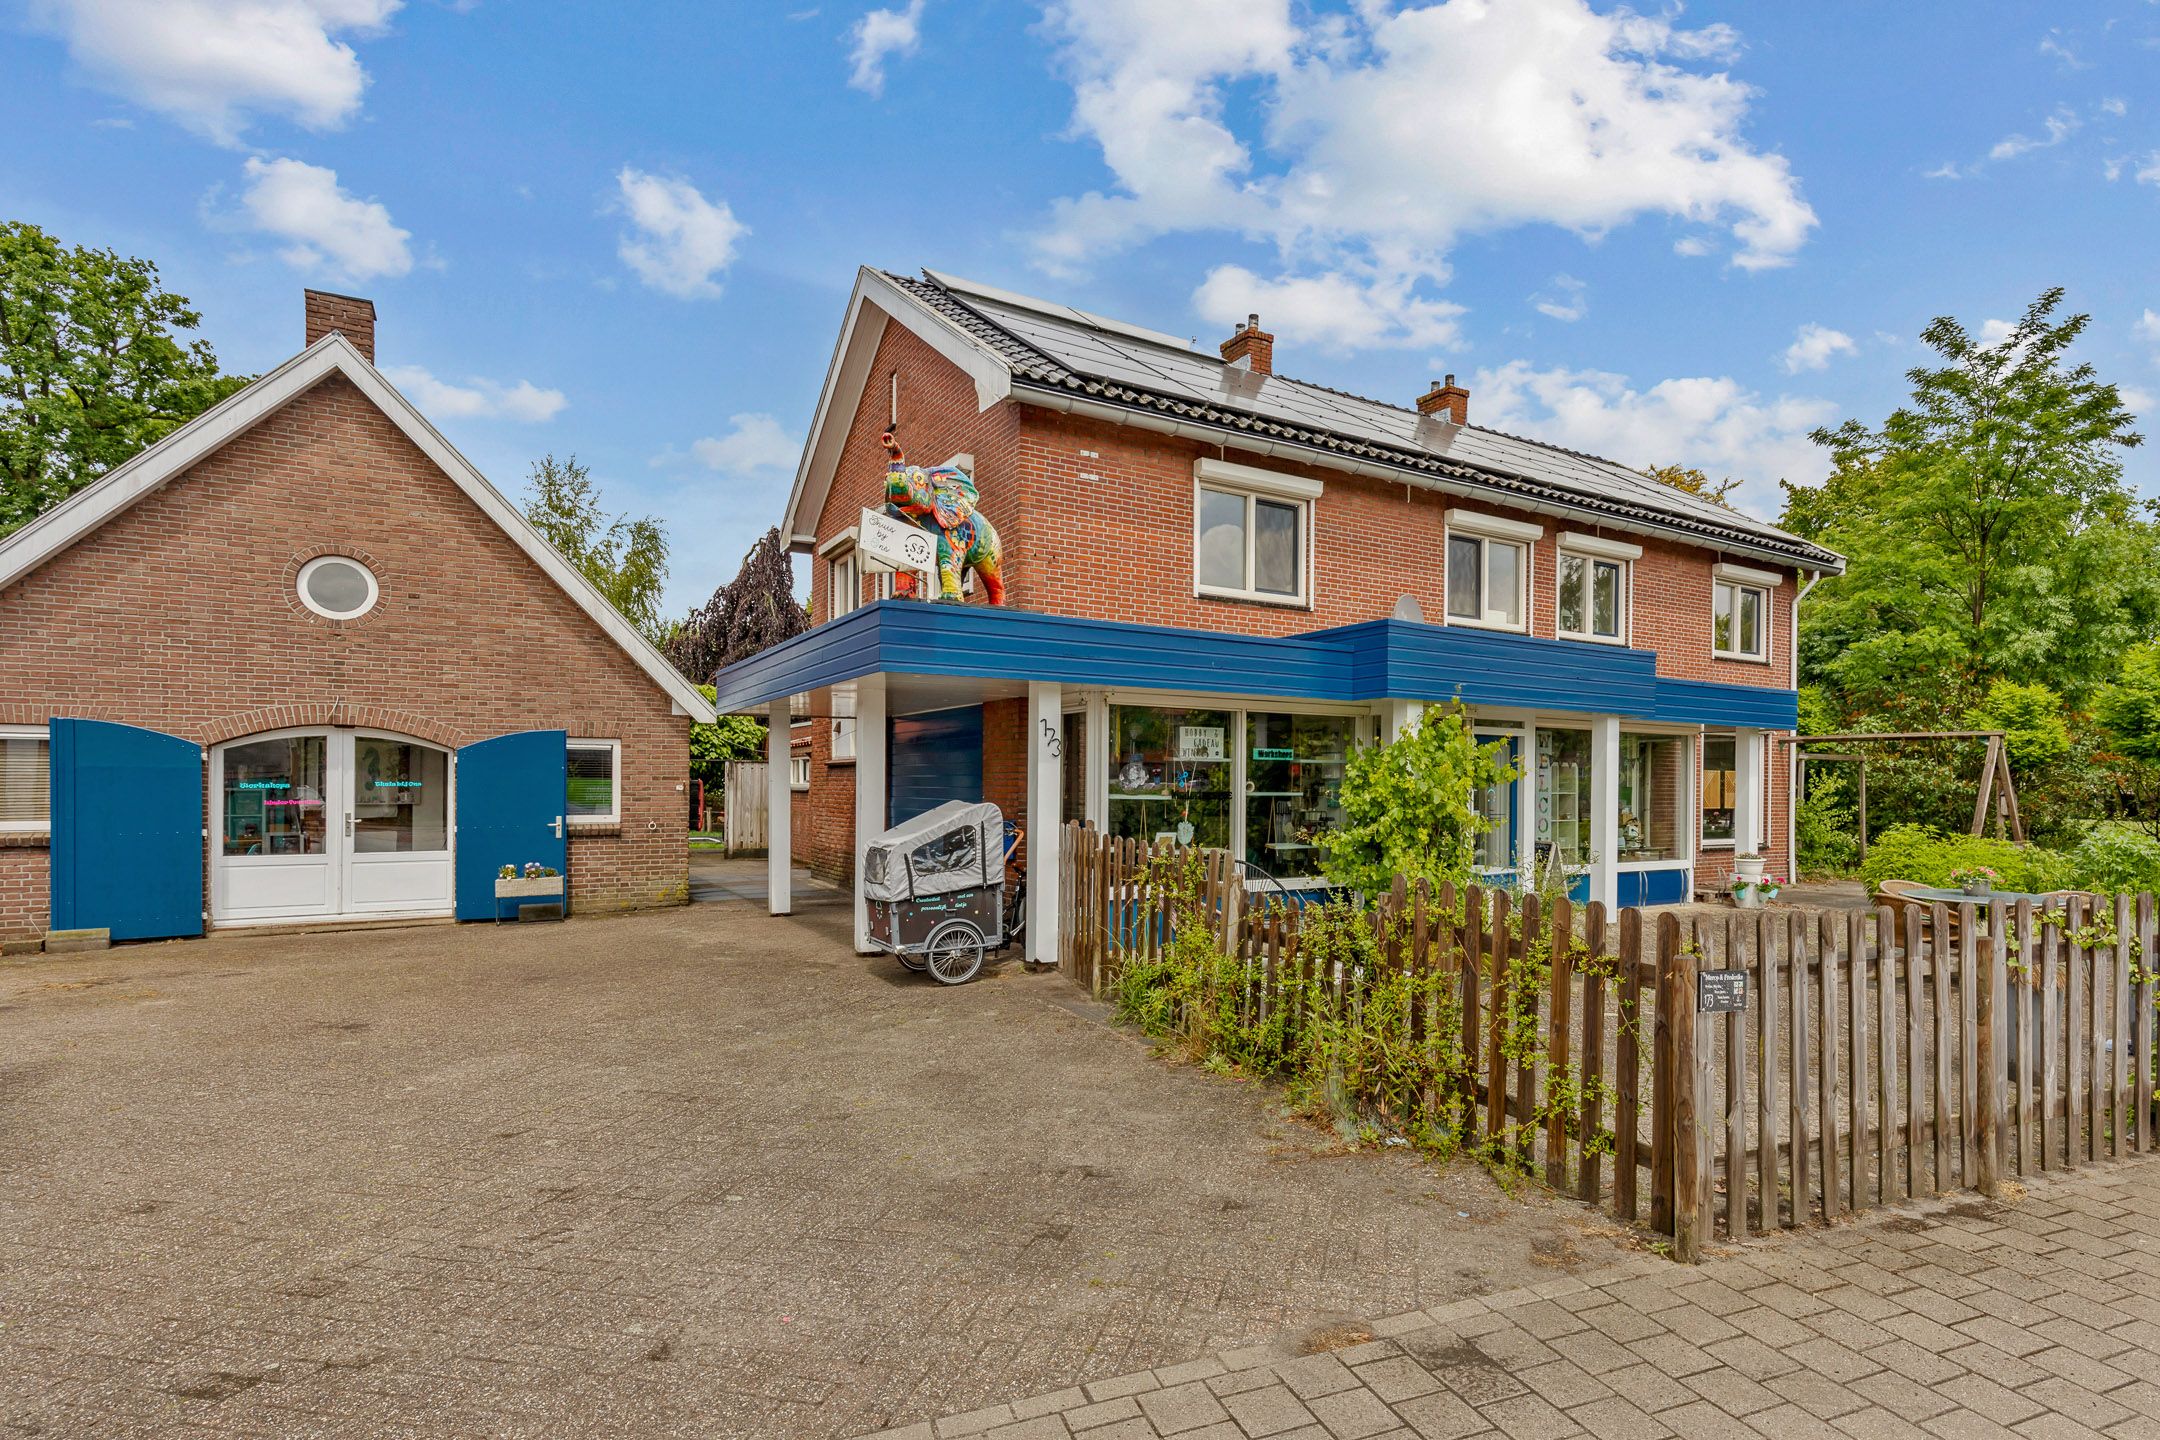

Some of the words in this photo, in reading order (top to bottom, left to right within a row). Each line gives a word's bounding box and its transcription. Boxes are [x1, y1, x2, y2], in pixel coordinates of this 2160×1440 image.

[1185, 728, 1207, 737] HOBBY
[1040, 718, 1062, 758] 173
[1194, 739, 1220, 748] CADEAU
